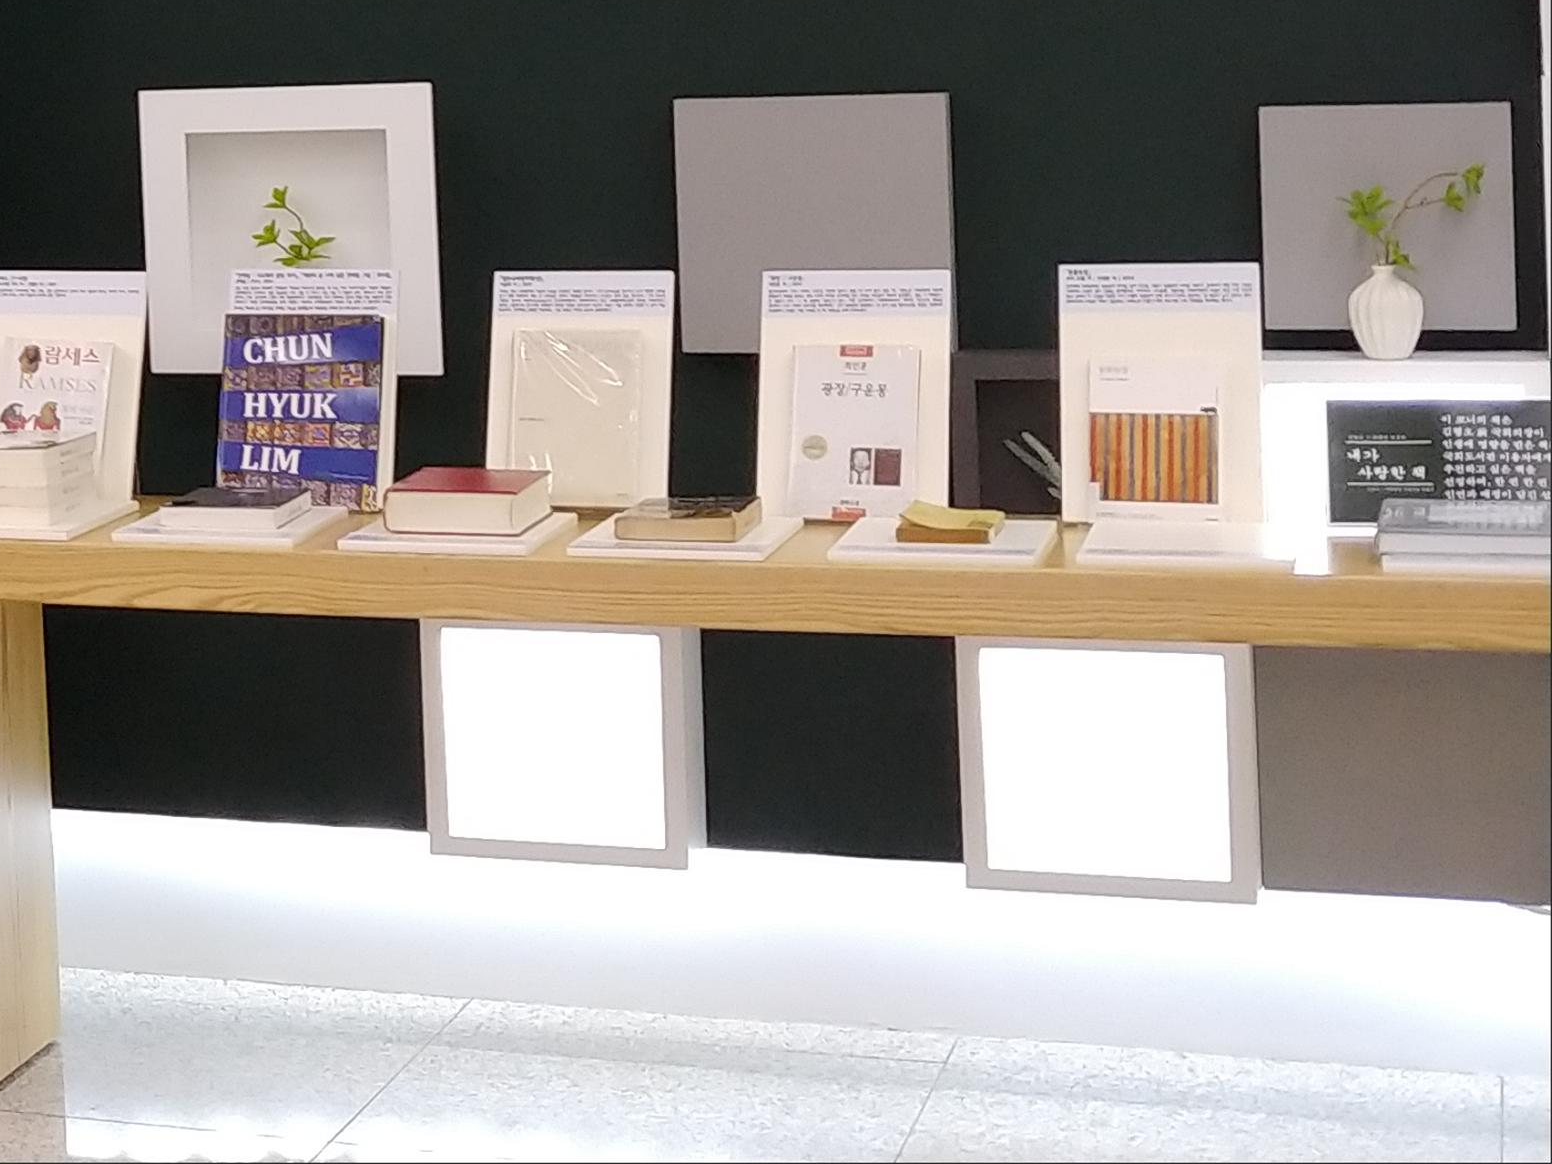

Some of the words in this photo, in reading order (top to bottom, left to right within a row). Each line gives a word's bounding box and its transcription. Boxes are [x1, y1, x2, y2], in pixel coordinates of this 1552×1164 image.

[44, 346, 101, 367] 람세스
[242, 332, 334, 366] CHUN
[242, 391, 339, 421] HYUK
[240, 443, 303, 475] LIM
[1346, 447, 1380, 463] 내가
[1357, 465, 1407, 481] 사랑한
